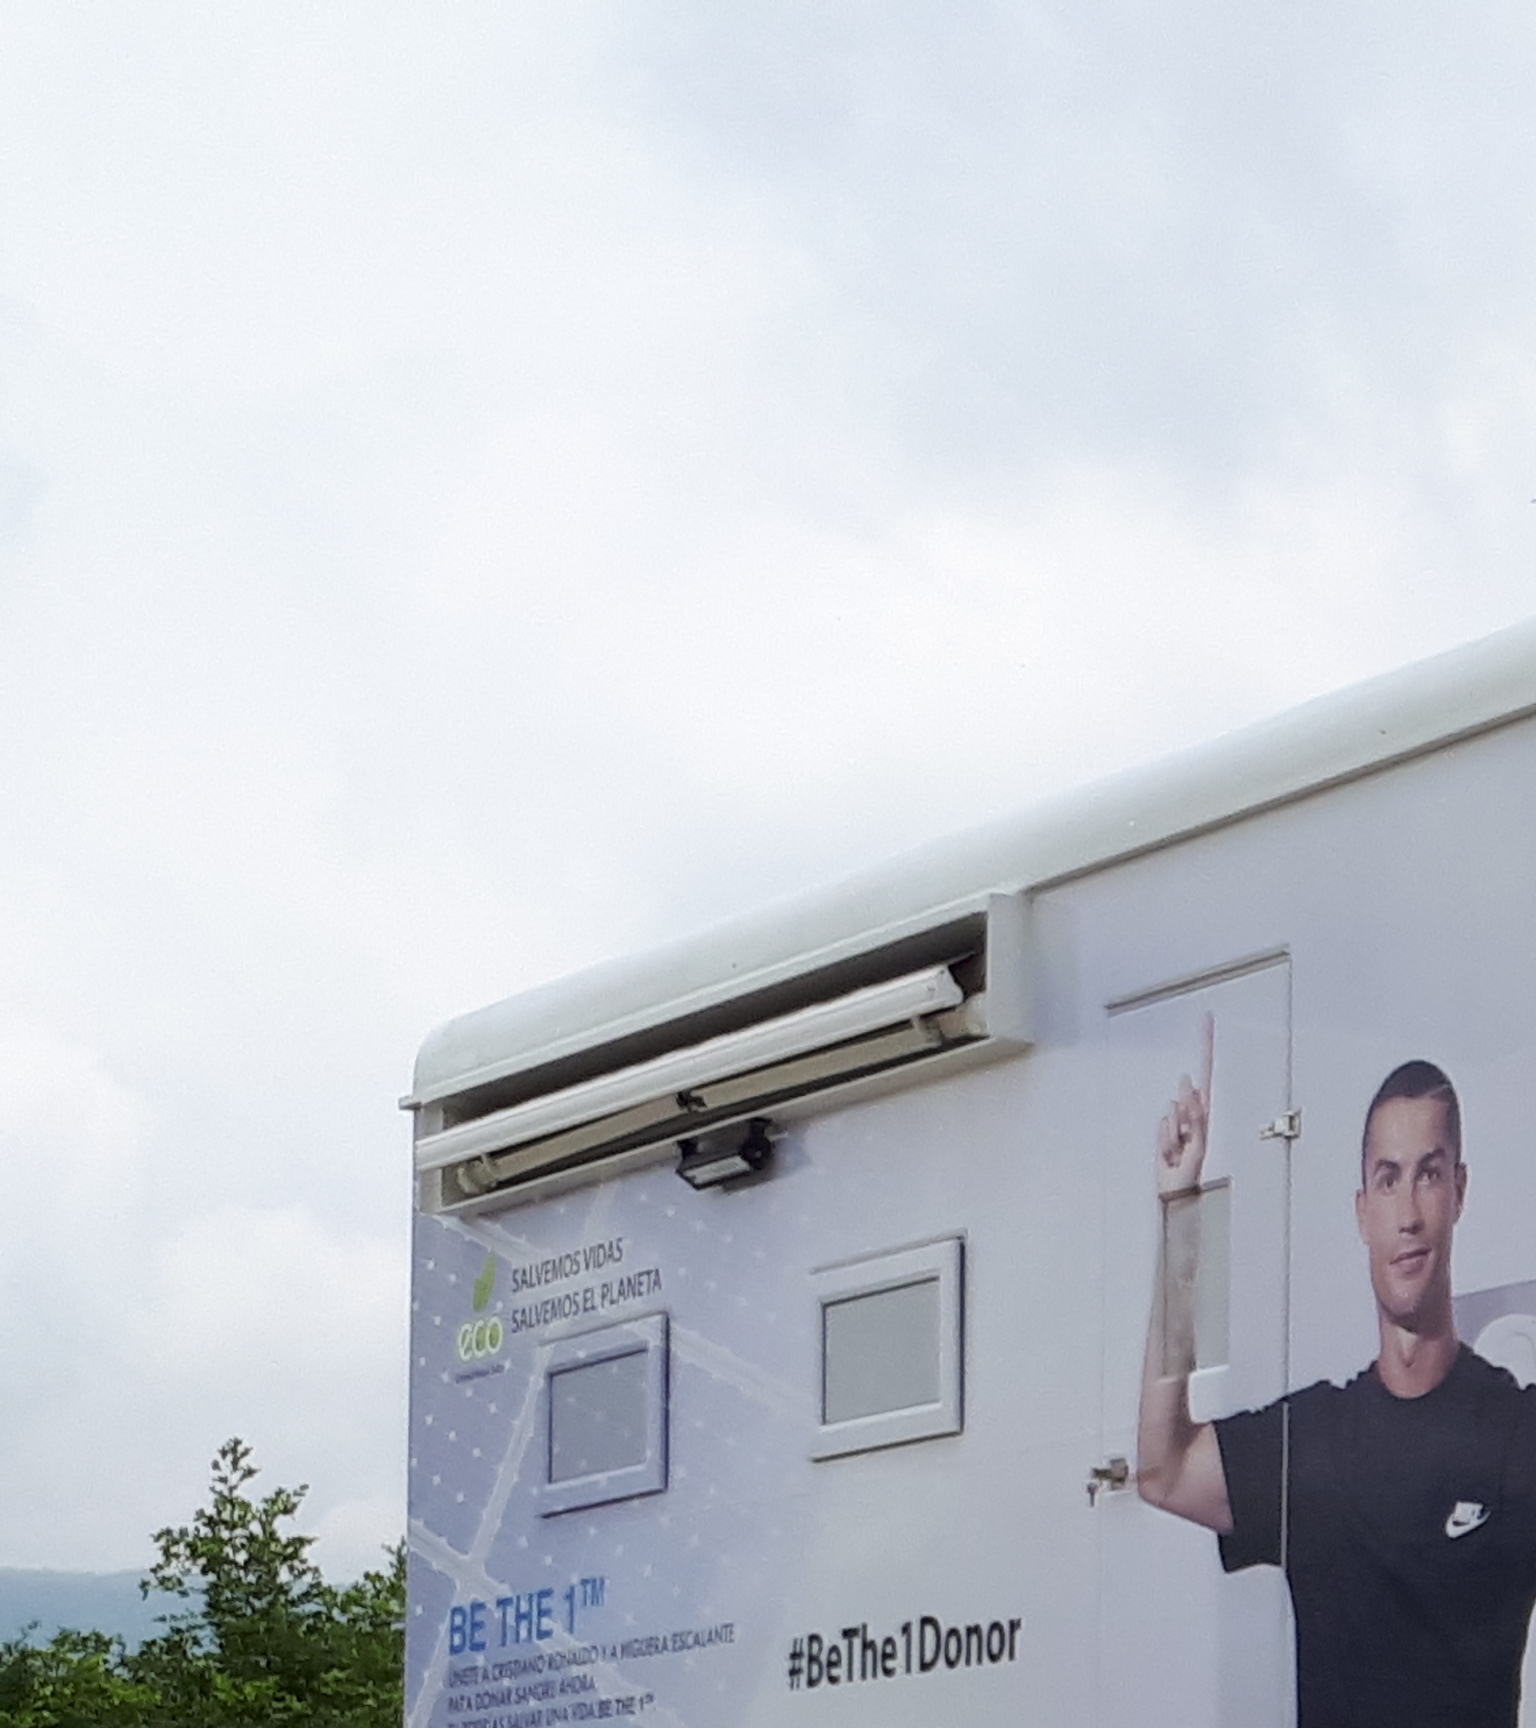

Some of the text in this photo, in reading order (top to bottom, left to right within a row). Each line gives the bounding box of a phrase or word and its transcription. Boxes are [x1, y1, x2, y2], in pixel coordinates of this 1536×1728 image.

[511, 1238, 623, 1293] SALVEMOS VIDAS
[511, 1268, 662, 1333] SALVEMOS EL PLANETA
[449, 1601, 487, 1657] BE
[496, 1587, 555, 1648] THE
[672, 1622, 735, 1653] ESCALANTE
[788, 1615, 1022, 1691] #BeThe1Donor
